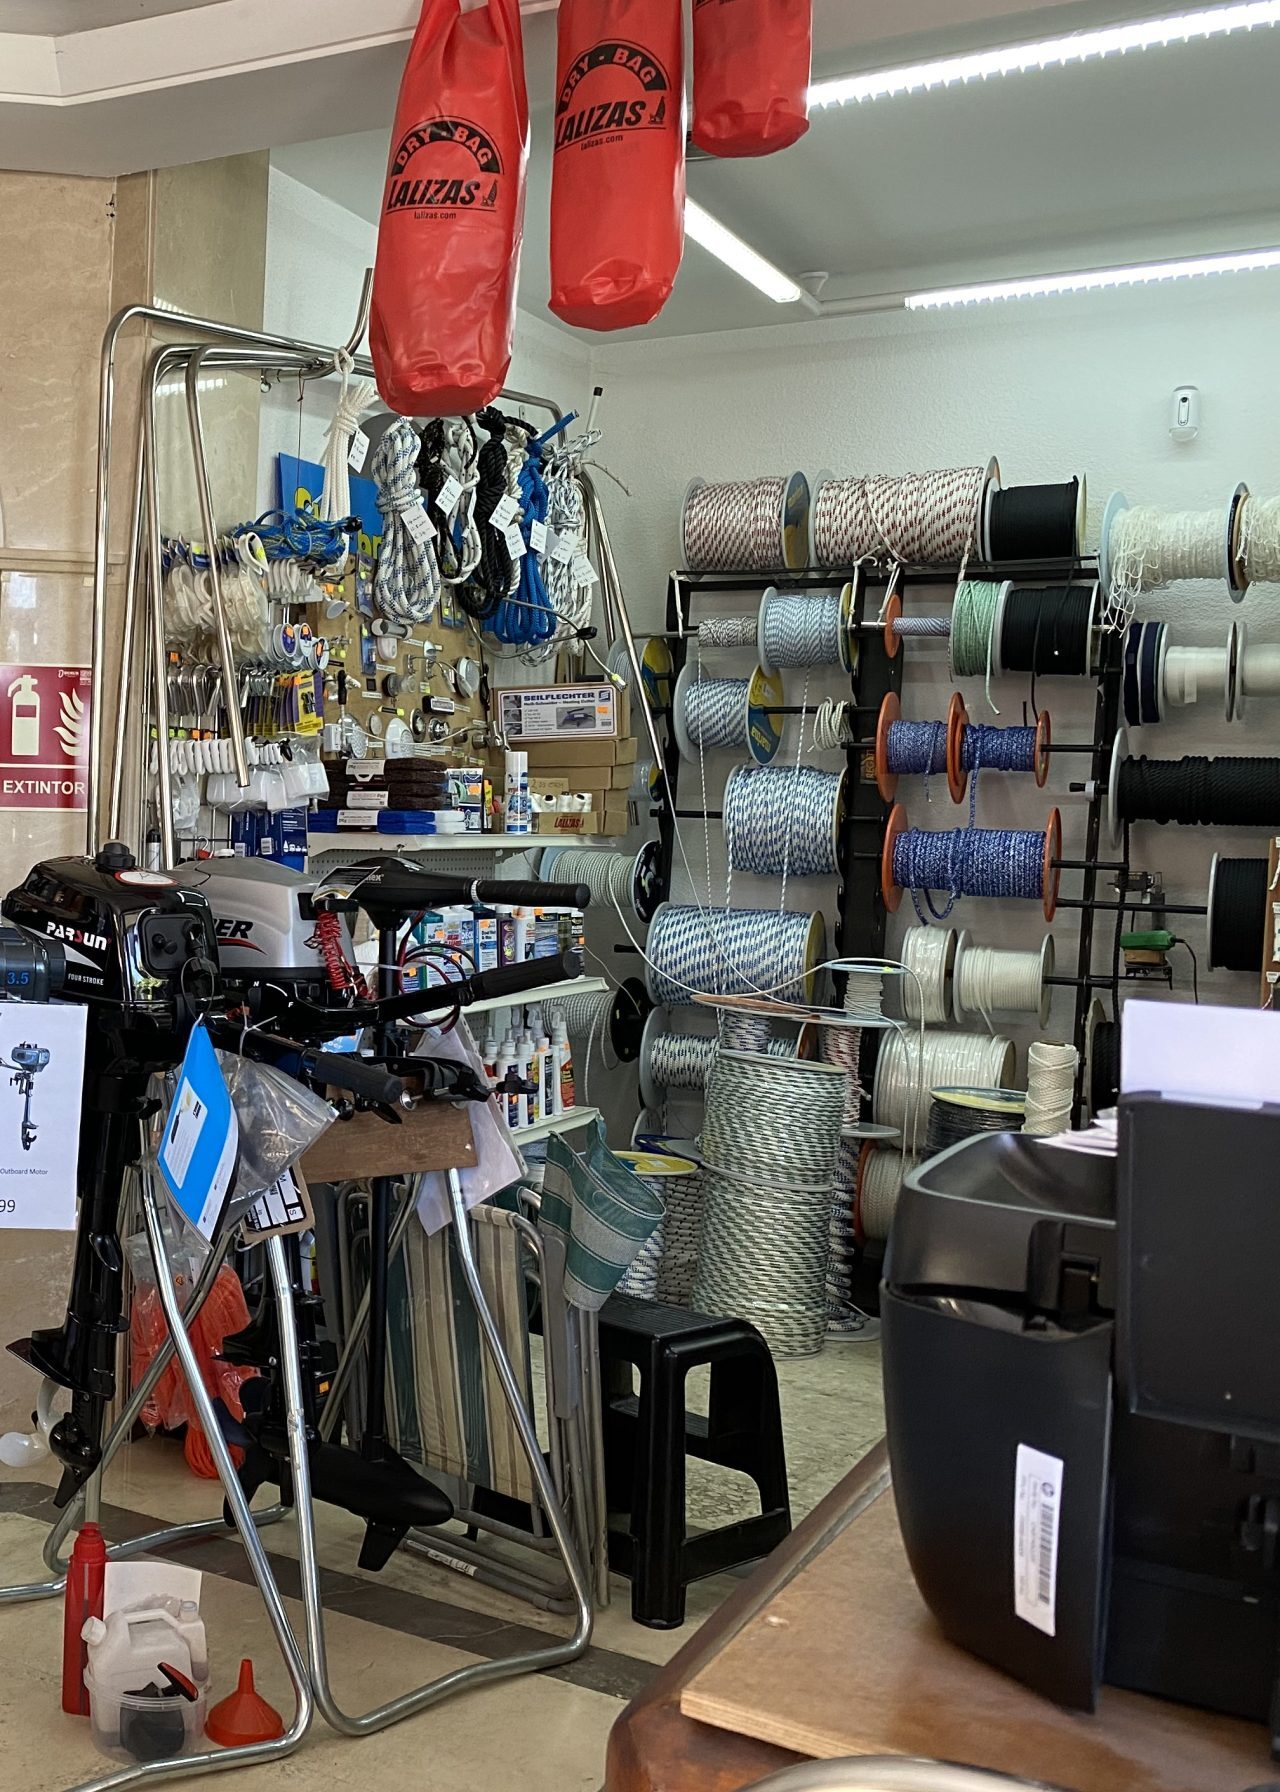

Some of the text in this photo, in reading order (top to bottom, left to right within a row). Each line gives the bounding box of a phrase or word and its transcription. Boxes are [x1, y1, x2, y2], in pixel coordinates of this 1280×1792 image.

[561, 56, 590, 103] DRY
[612, 48, 657, 83] BAG
[555, 101, 647, 150] LALIZAS
[396, 127, 432, 166] DRY
[453, 126, 493, 165] BAG
[581, 135, 624, 151] lalizas.com
[387, 179, 481, 211] LALIZAS
[414, 211, 457, 219] lalizas.com
[524, 692, 595, 701] SEILFLECHTER
[3, 779, 85, 795] EXTINTOR
[46, 921, 107, 951] PARSUN
[7, 972, 30, 985] 3.5
[67, 973, 104, 986] FOUR STROKE
[0, 1167, 28, 1175] Outboard
